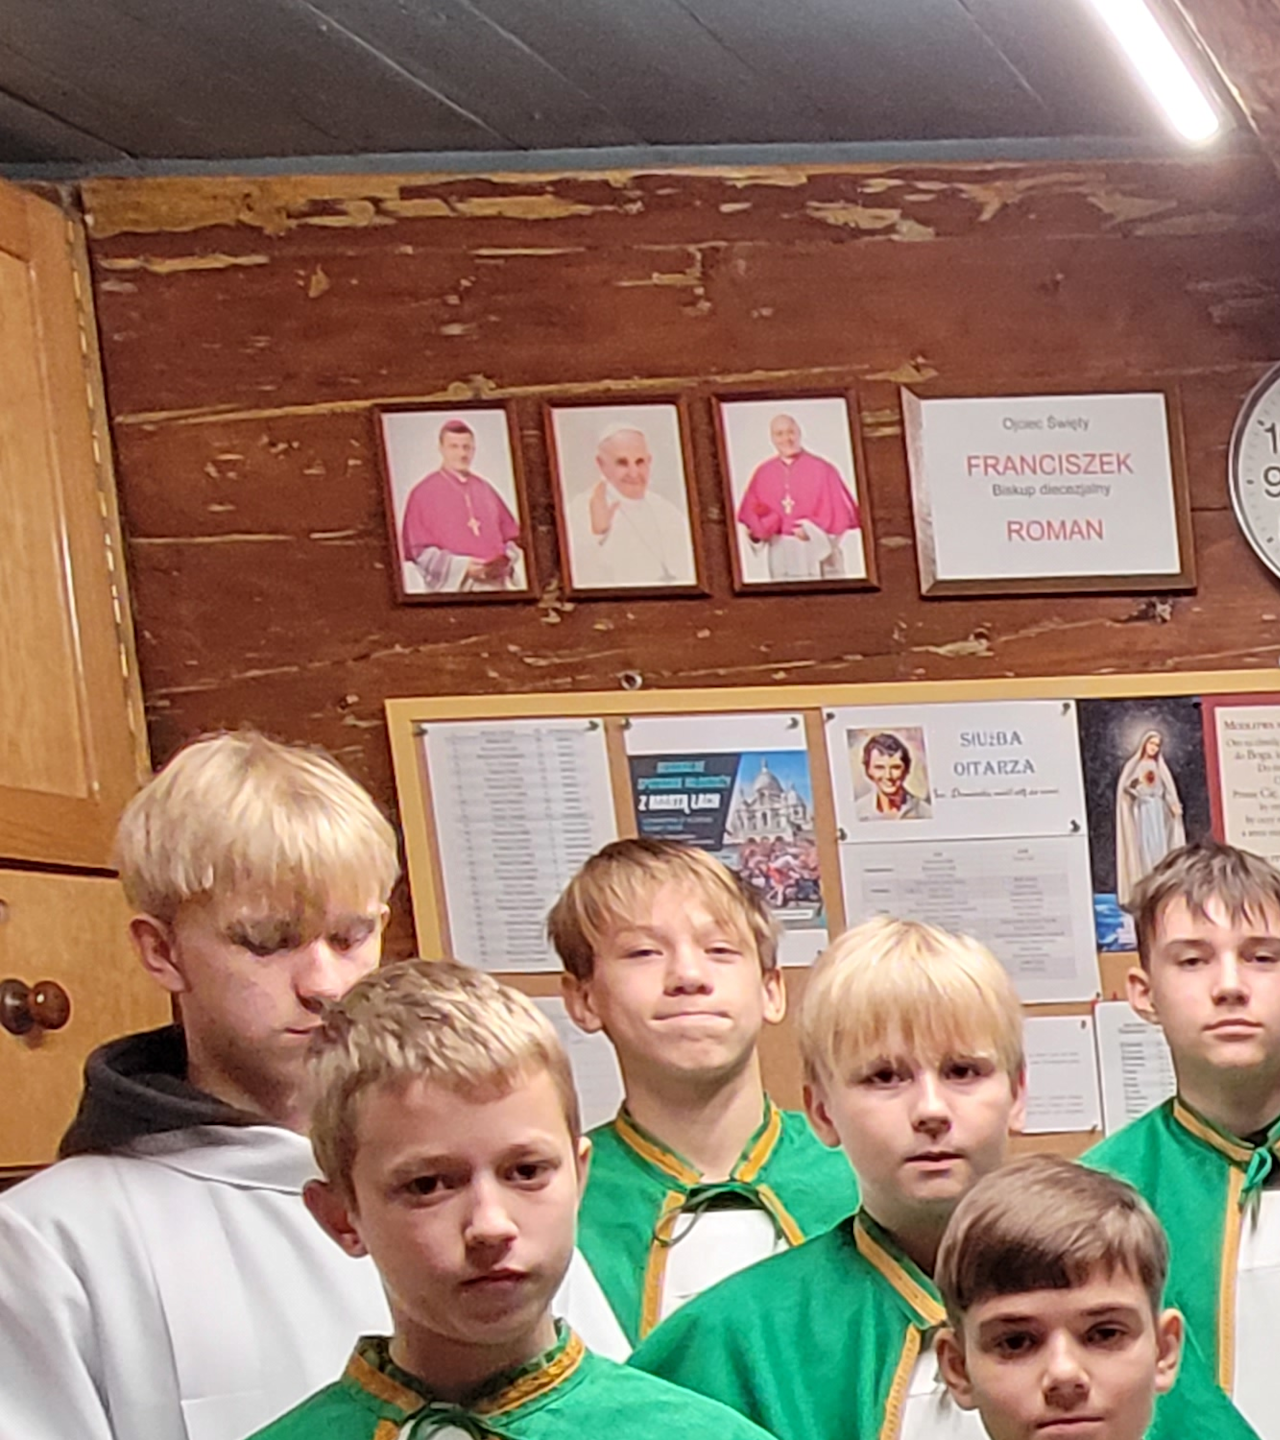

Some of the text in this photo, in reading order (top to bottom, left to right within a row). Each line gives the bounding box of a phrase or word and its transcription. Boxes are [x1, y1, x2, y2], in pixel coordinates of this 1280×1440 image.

[1003, 415, 1090, 433] Ojciec Święty
[966, 453, 1134, 477] FRANCISZEK
[992, 483, 1111, 498] Biskup diecezjalny
[1006, 519, 1104, 542] ROMAN
